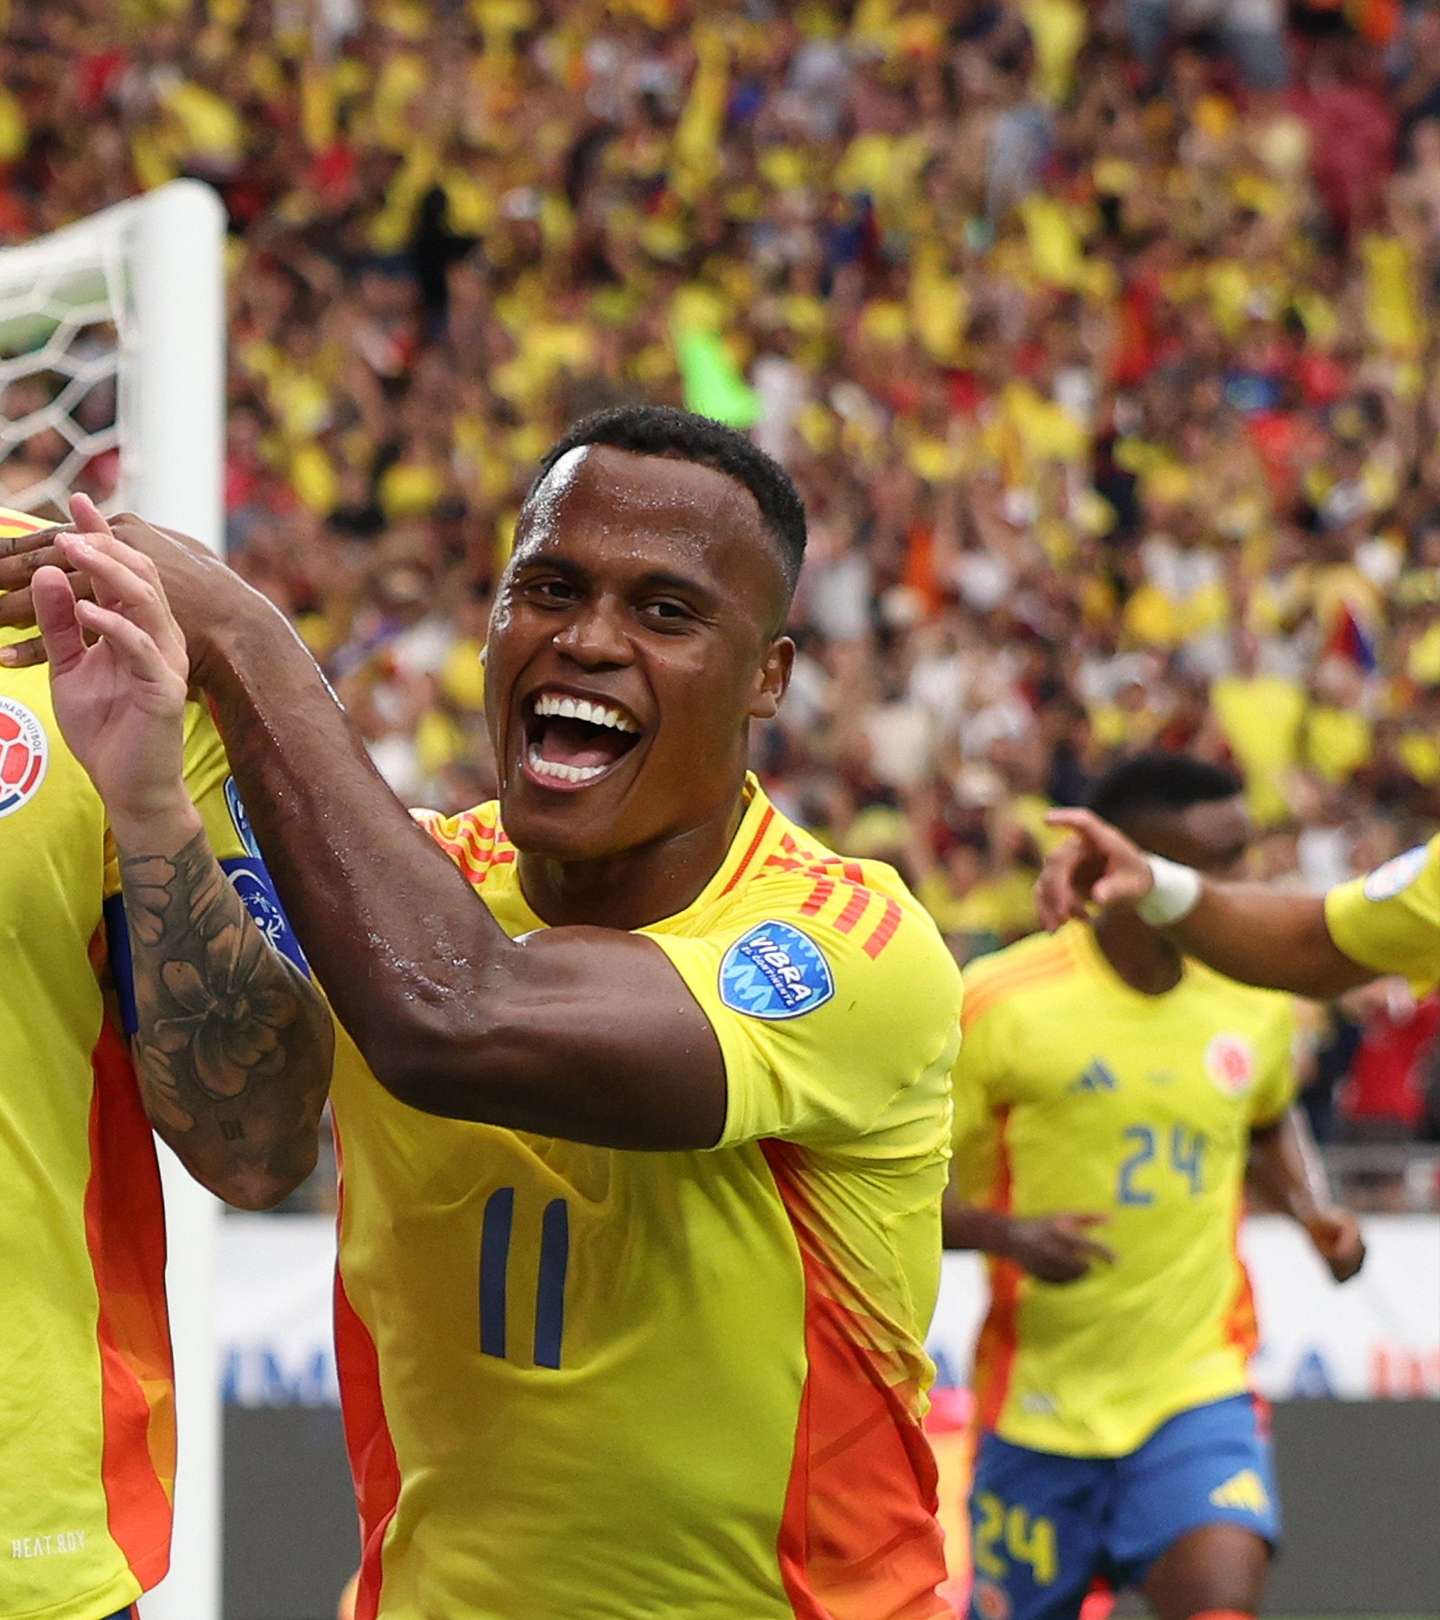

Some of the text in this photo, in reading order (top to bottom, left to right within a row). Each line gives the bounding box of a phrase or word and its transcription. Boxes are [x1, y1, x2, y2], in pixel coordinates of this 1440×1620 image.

[15, 709, 27, 720] DE
[748, 935, 813, 1002] VIBRA
[1118, 1121, 1208, 1206] 24
[479, 1187, 568, 1370] 11
[974, 1490, 1058, 1587] 24
